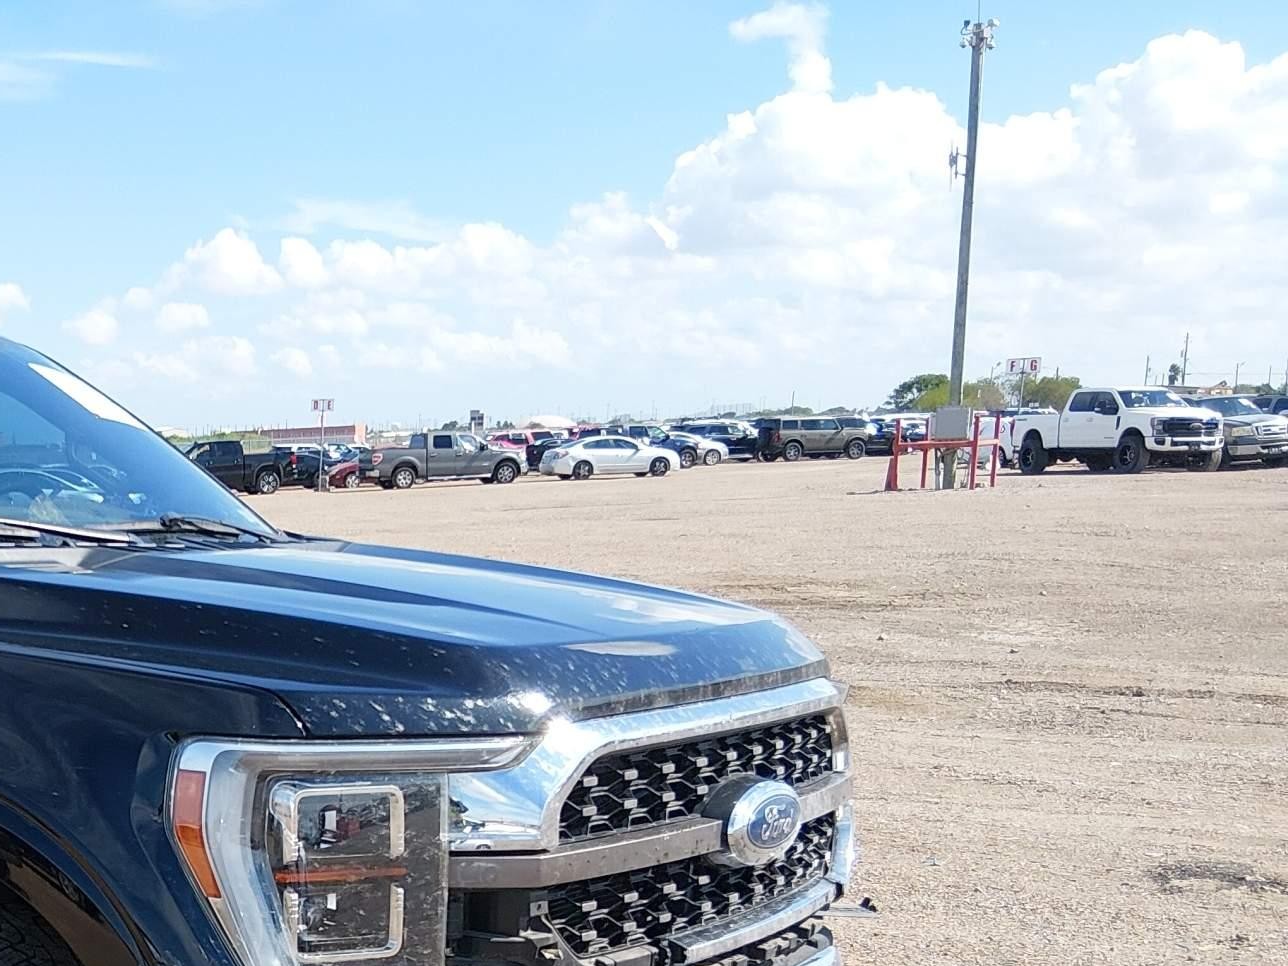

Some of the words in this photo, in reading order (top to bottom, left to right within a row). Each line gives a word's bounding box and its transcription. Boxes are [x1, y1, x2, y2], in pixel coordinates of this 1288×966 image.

[1010, 360, 1016, 372] F
[1030, 360, 1038, 371] G
[761, 804, 794, 840] Ford
